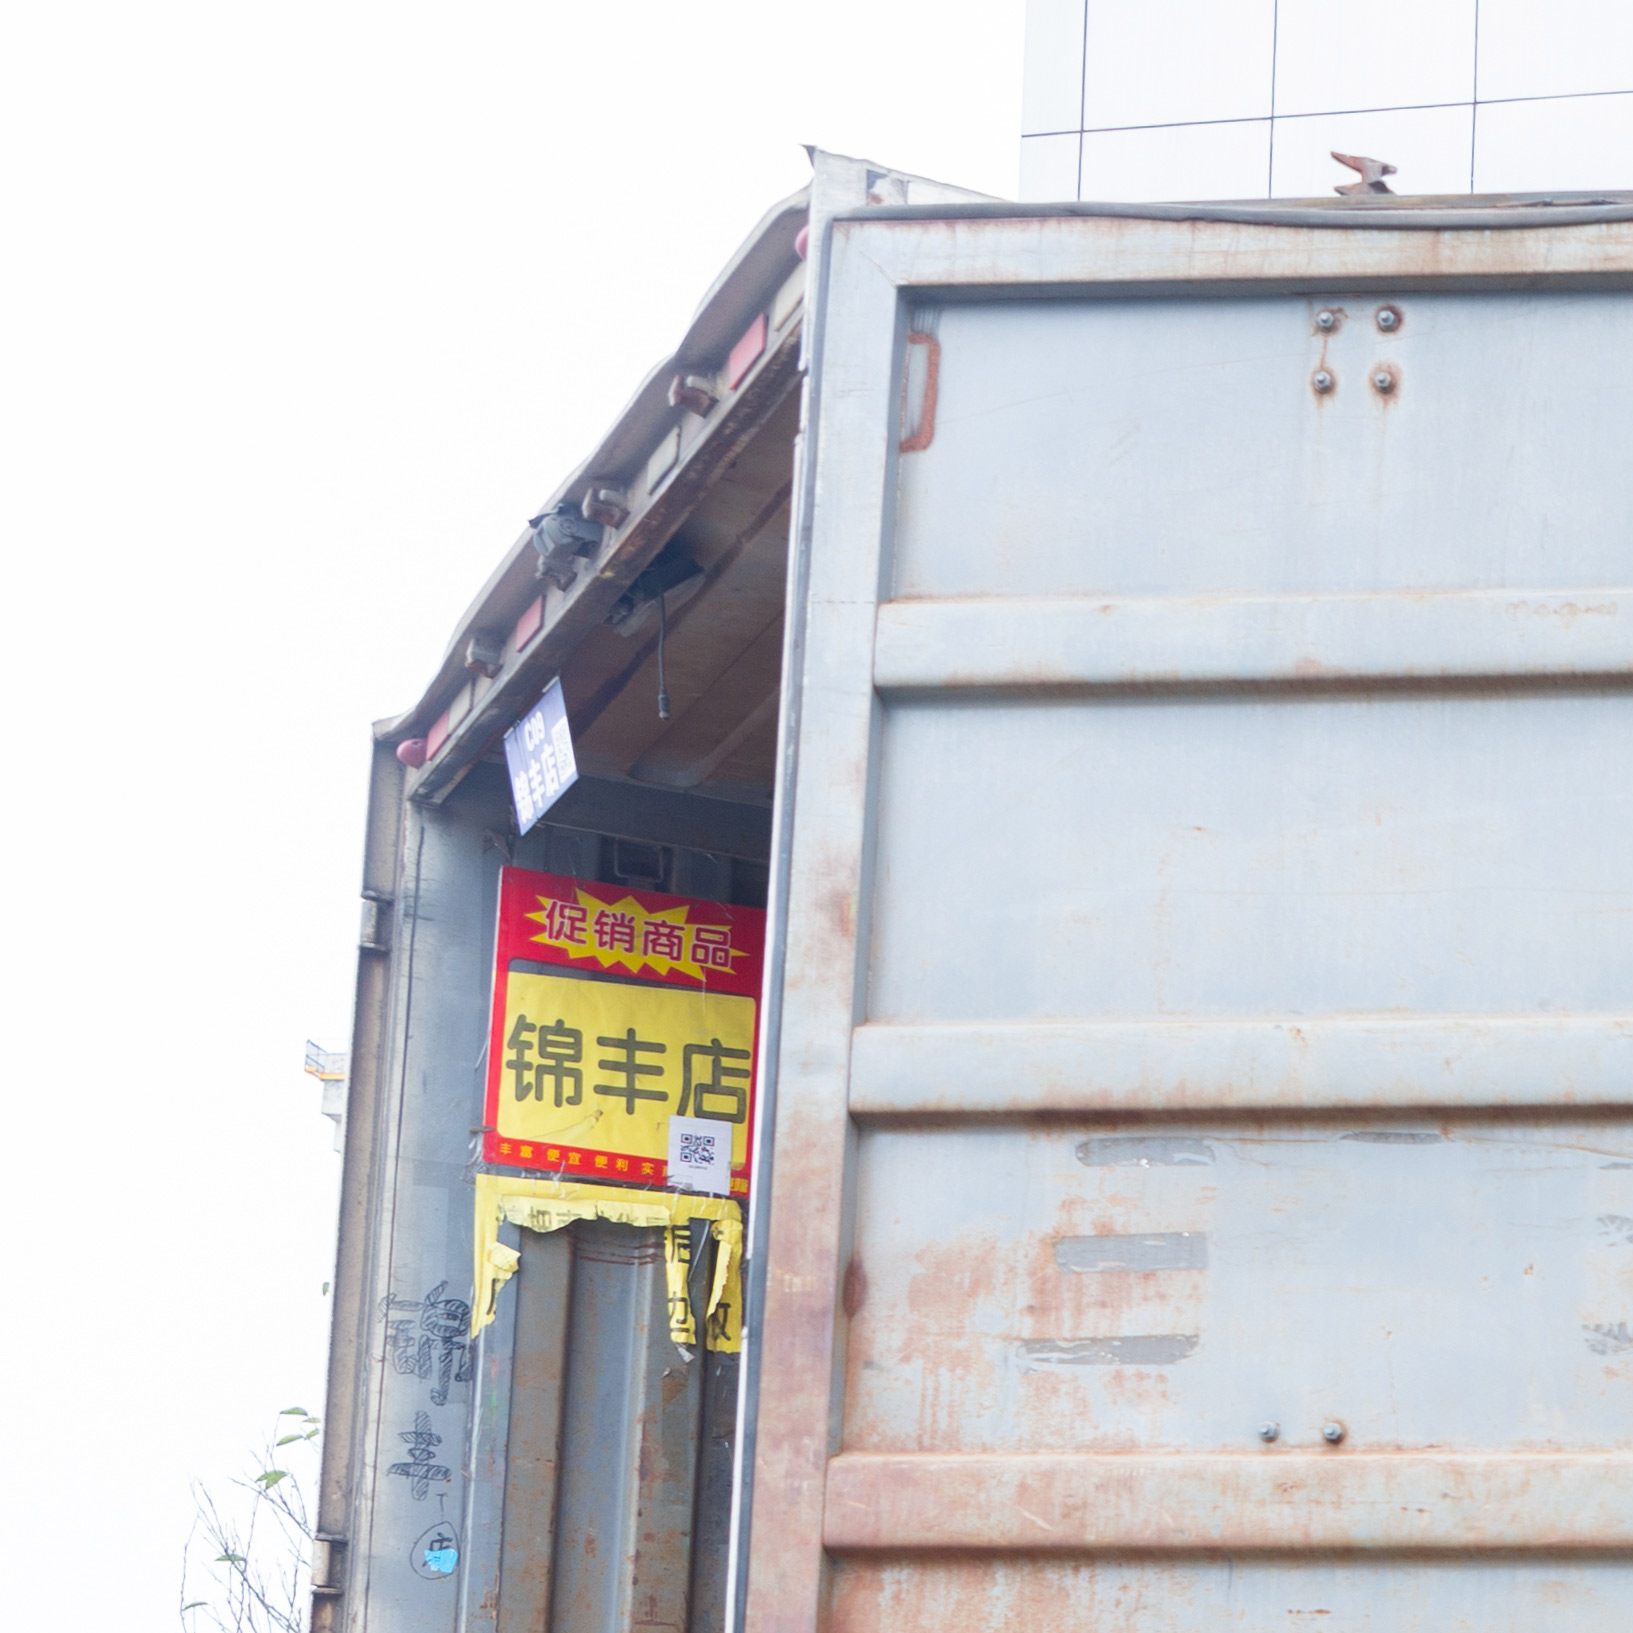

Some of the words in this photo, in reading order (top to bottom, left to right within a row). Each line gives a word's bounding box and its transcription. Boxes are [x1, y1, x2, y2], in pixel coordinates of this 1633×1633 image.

[543, 899, 732, 970] 促销商品
[506, 1013, 751, 1125] 锦丰店
[500, 1142, 533, 1159] 丰富
[547, 1148, 582, 1166] 便宜
[594, 1155, 629, 1172] 便利
[641, 1161, 668, 1178] 实
